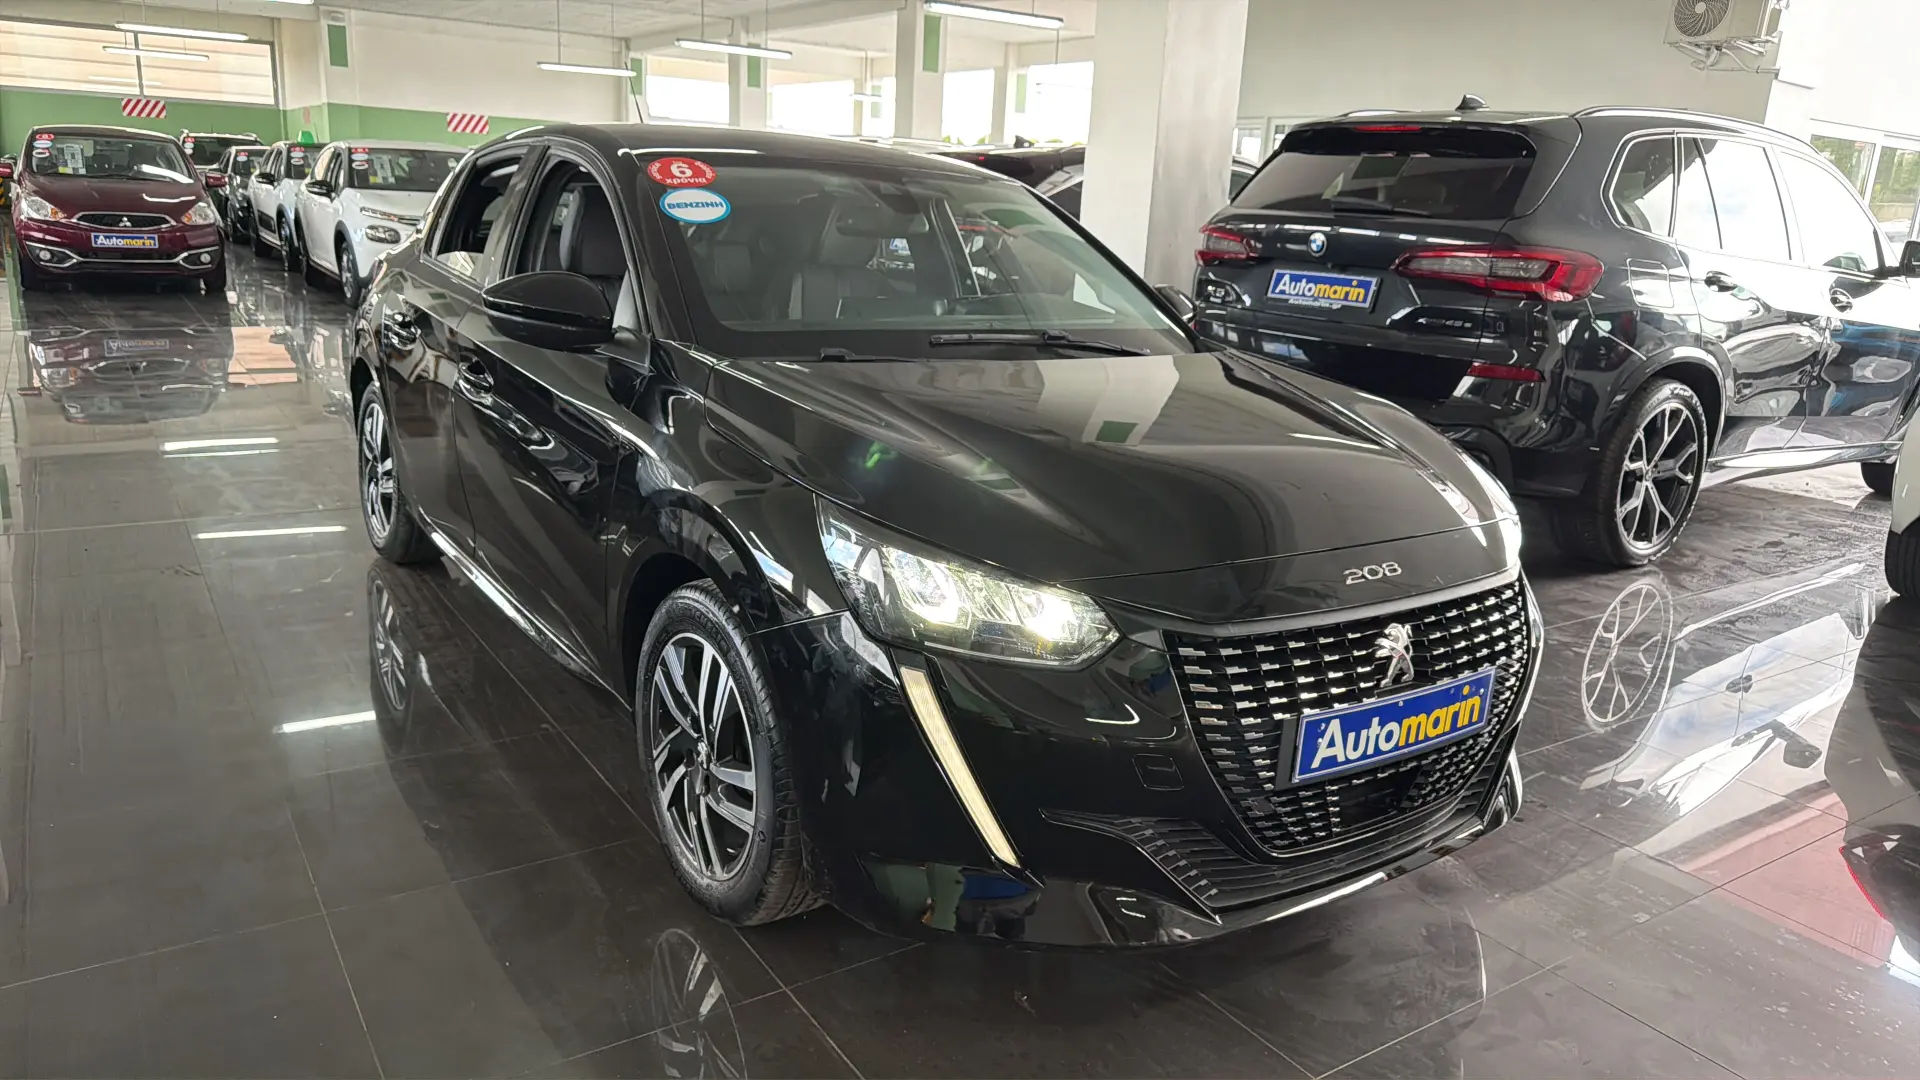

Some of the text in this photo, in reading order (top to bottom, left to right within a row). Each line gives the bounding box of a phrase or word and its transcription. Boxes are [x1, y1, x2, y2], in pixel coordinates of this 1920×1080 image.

[670, 161, 693, 178] 6
[96, 235, 155, 246] Automarin
[1275, 274, 1365, 303] Automarin
[1343, 561, 1402, 585] 208
[1311, 685, 1481, 769] Automarin
